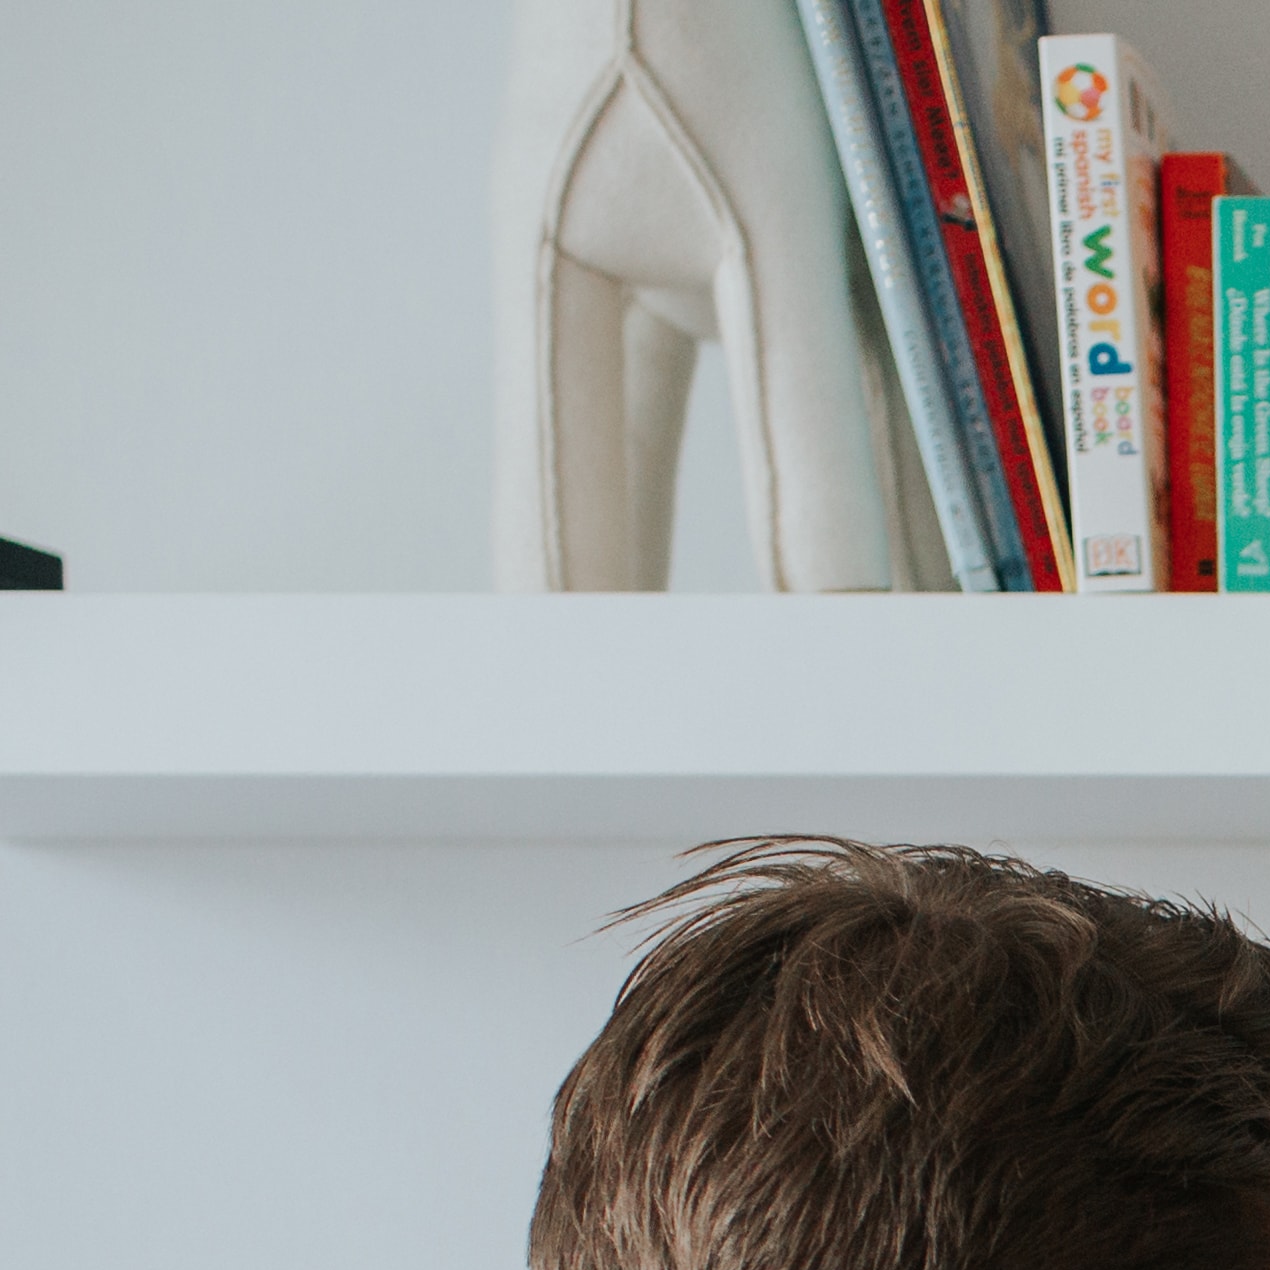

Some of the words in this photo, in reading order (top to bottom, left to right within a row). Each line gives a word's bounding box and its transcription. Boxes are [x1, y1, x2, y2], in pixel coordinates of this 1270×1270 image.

[1069, 127, 1099, 220] spanish
[1093, 127, 1116, 163] my
[1057, 161, 1070, 215] primer
[1099, 172, 1123, 219] first
[1062, 219, 1074, 257] libro
[1065, 260, 1076, 282] de
[1078, 222, 1134, 377] word
[1065, 286, 1081, 359] palabras
[1071, 362, 1081, 383] en
[1071, 387, 1087, 454] español
[1090, 386, 1114, 446] book
[1111, 384, 1138, 456] board
